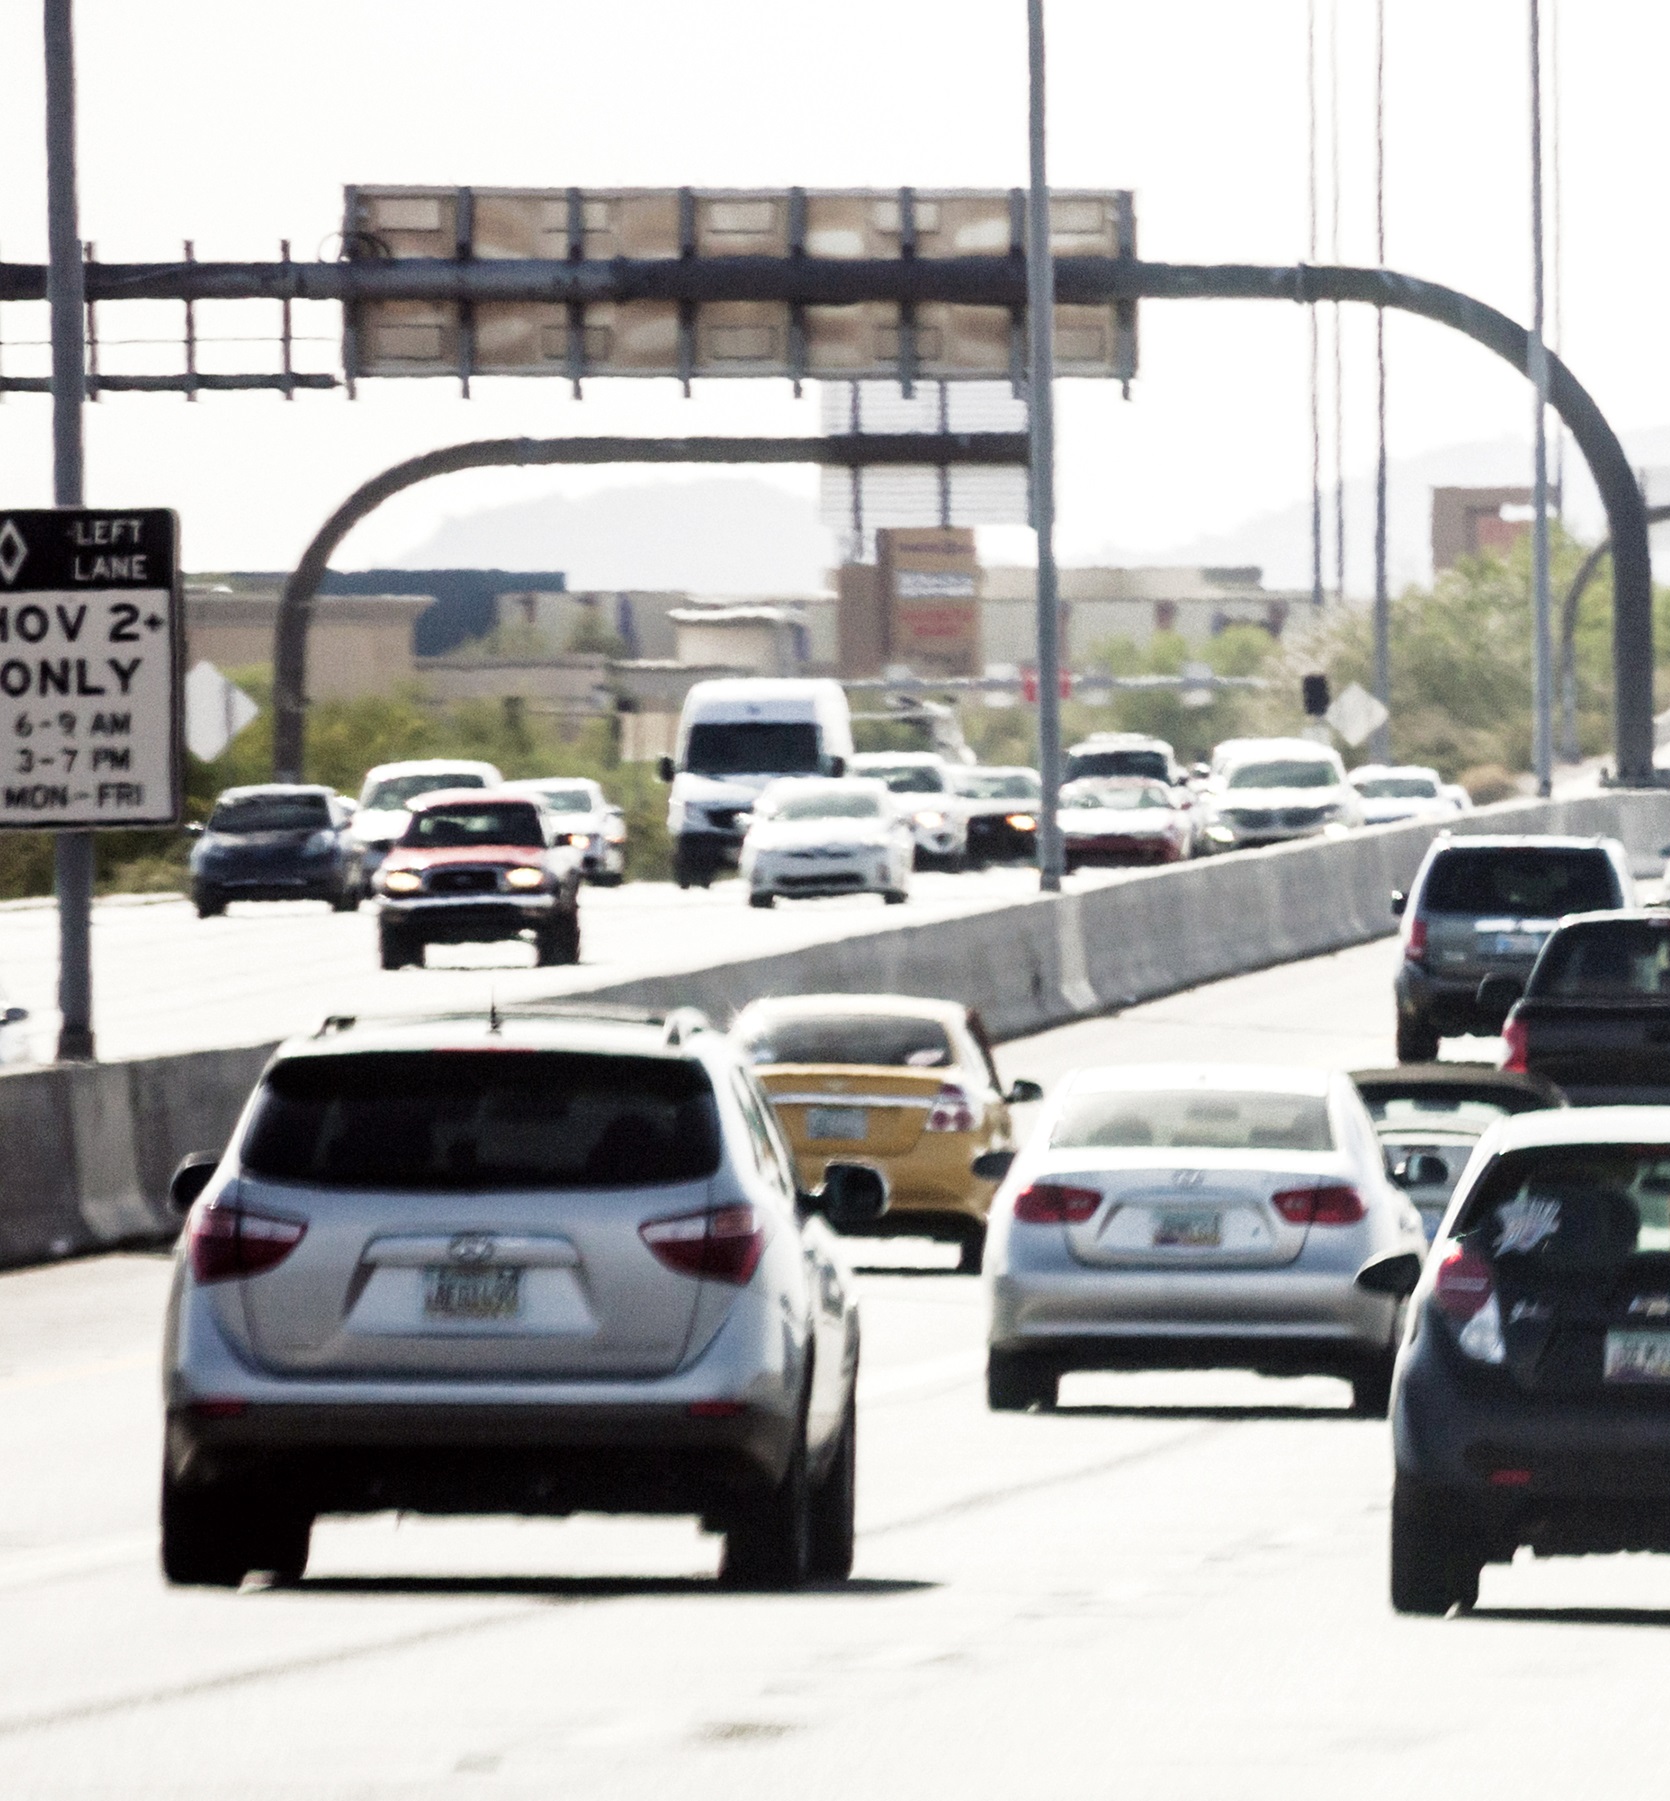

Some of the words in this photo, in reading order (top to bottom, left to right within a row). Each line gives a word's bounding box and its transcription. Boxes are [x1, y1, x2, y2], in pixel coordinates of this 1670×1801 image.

[76, 520, 142, 545] LEFT
[75, 555, 148, 581] LANE
[0, 604, 87, 643] OV
[109, 603, 164, 643] 2+
[0, 657, 142, 698] ONLY
[15, 710, 77, 737] 6-9
[91, 711, 132, 735] AM
[16, 748, 78, 774] 3-7
[92, 748, 130, 771] PM
